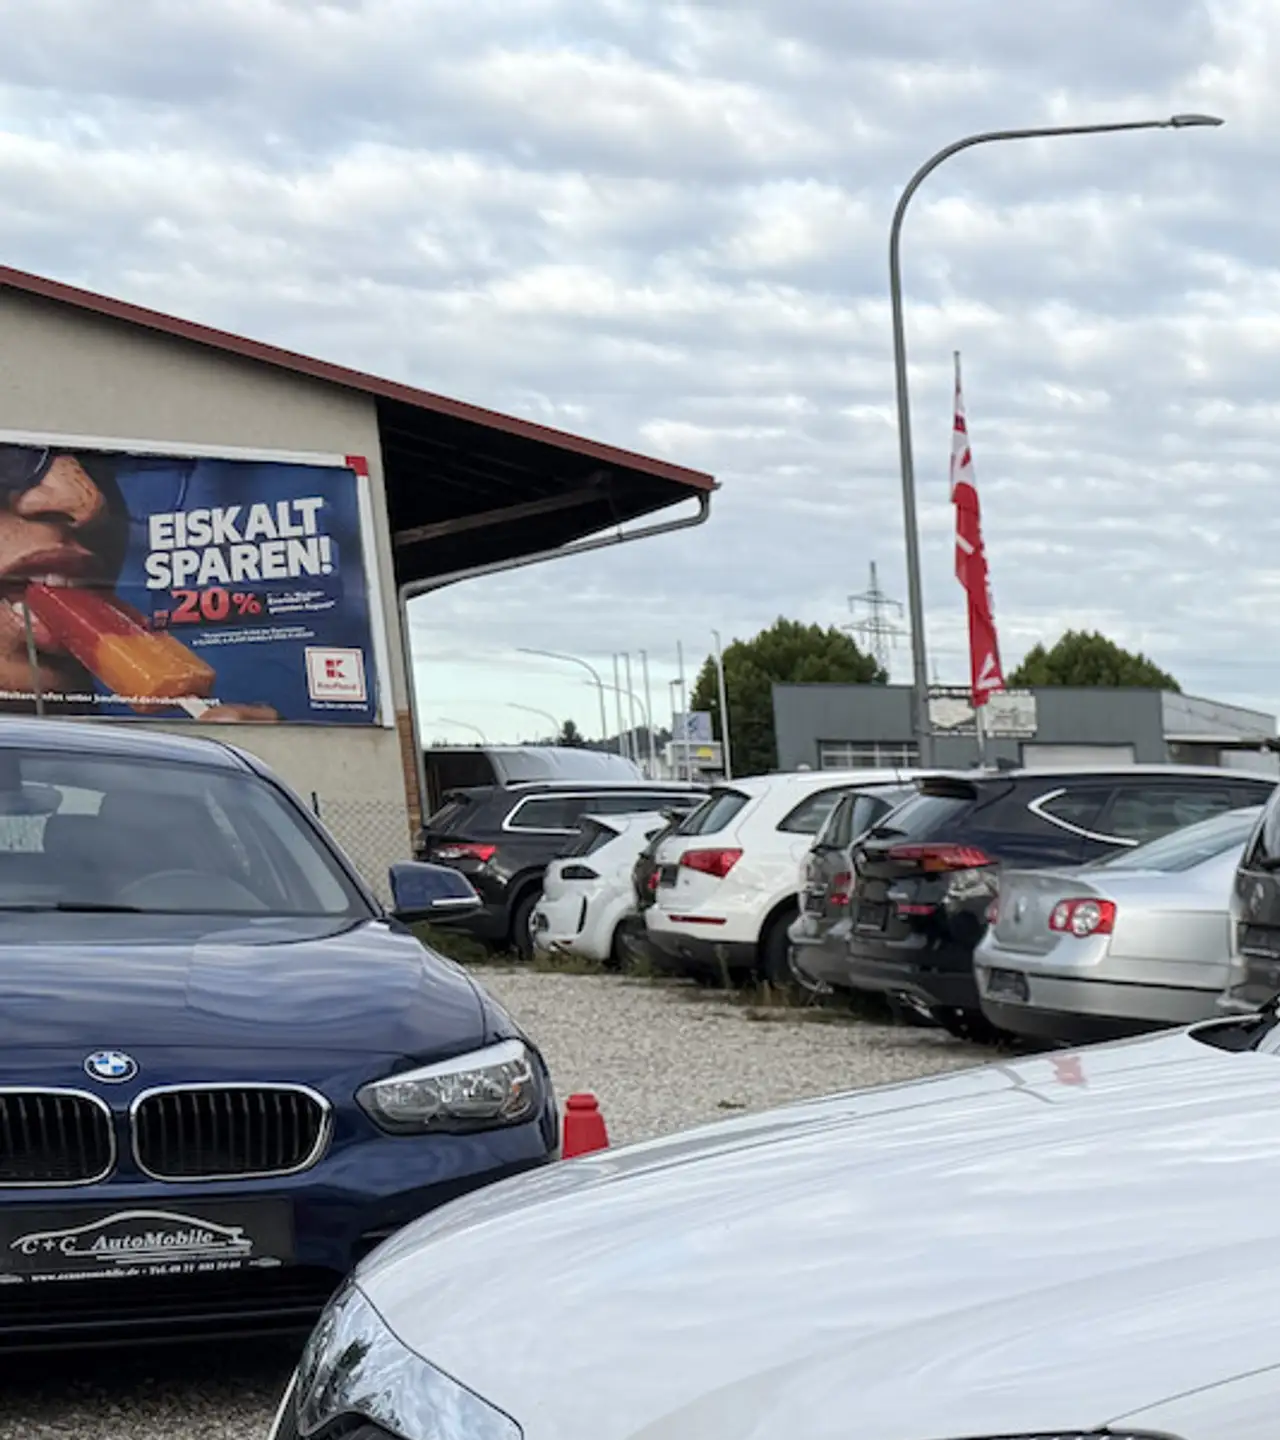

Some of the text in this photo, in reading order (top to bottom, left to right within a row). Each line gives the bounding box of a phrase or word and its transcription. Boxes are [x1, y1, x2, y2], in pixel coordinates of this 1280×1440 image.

[149, 497, 324, 551] EISKALT
[145, 536, 333, 589] SPAREN!
[91, 1229, 215, 1251] AutoMobile
